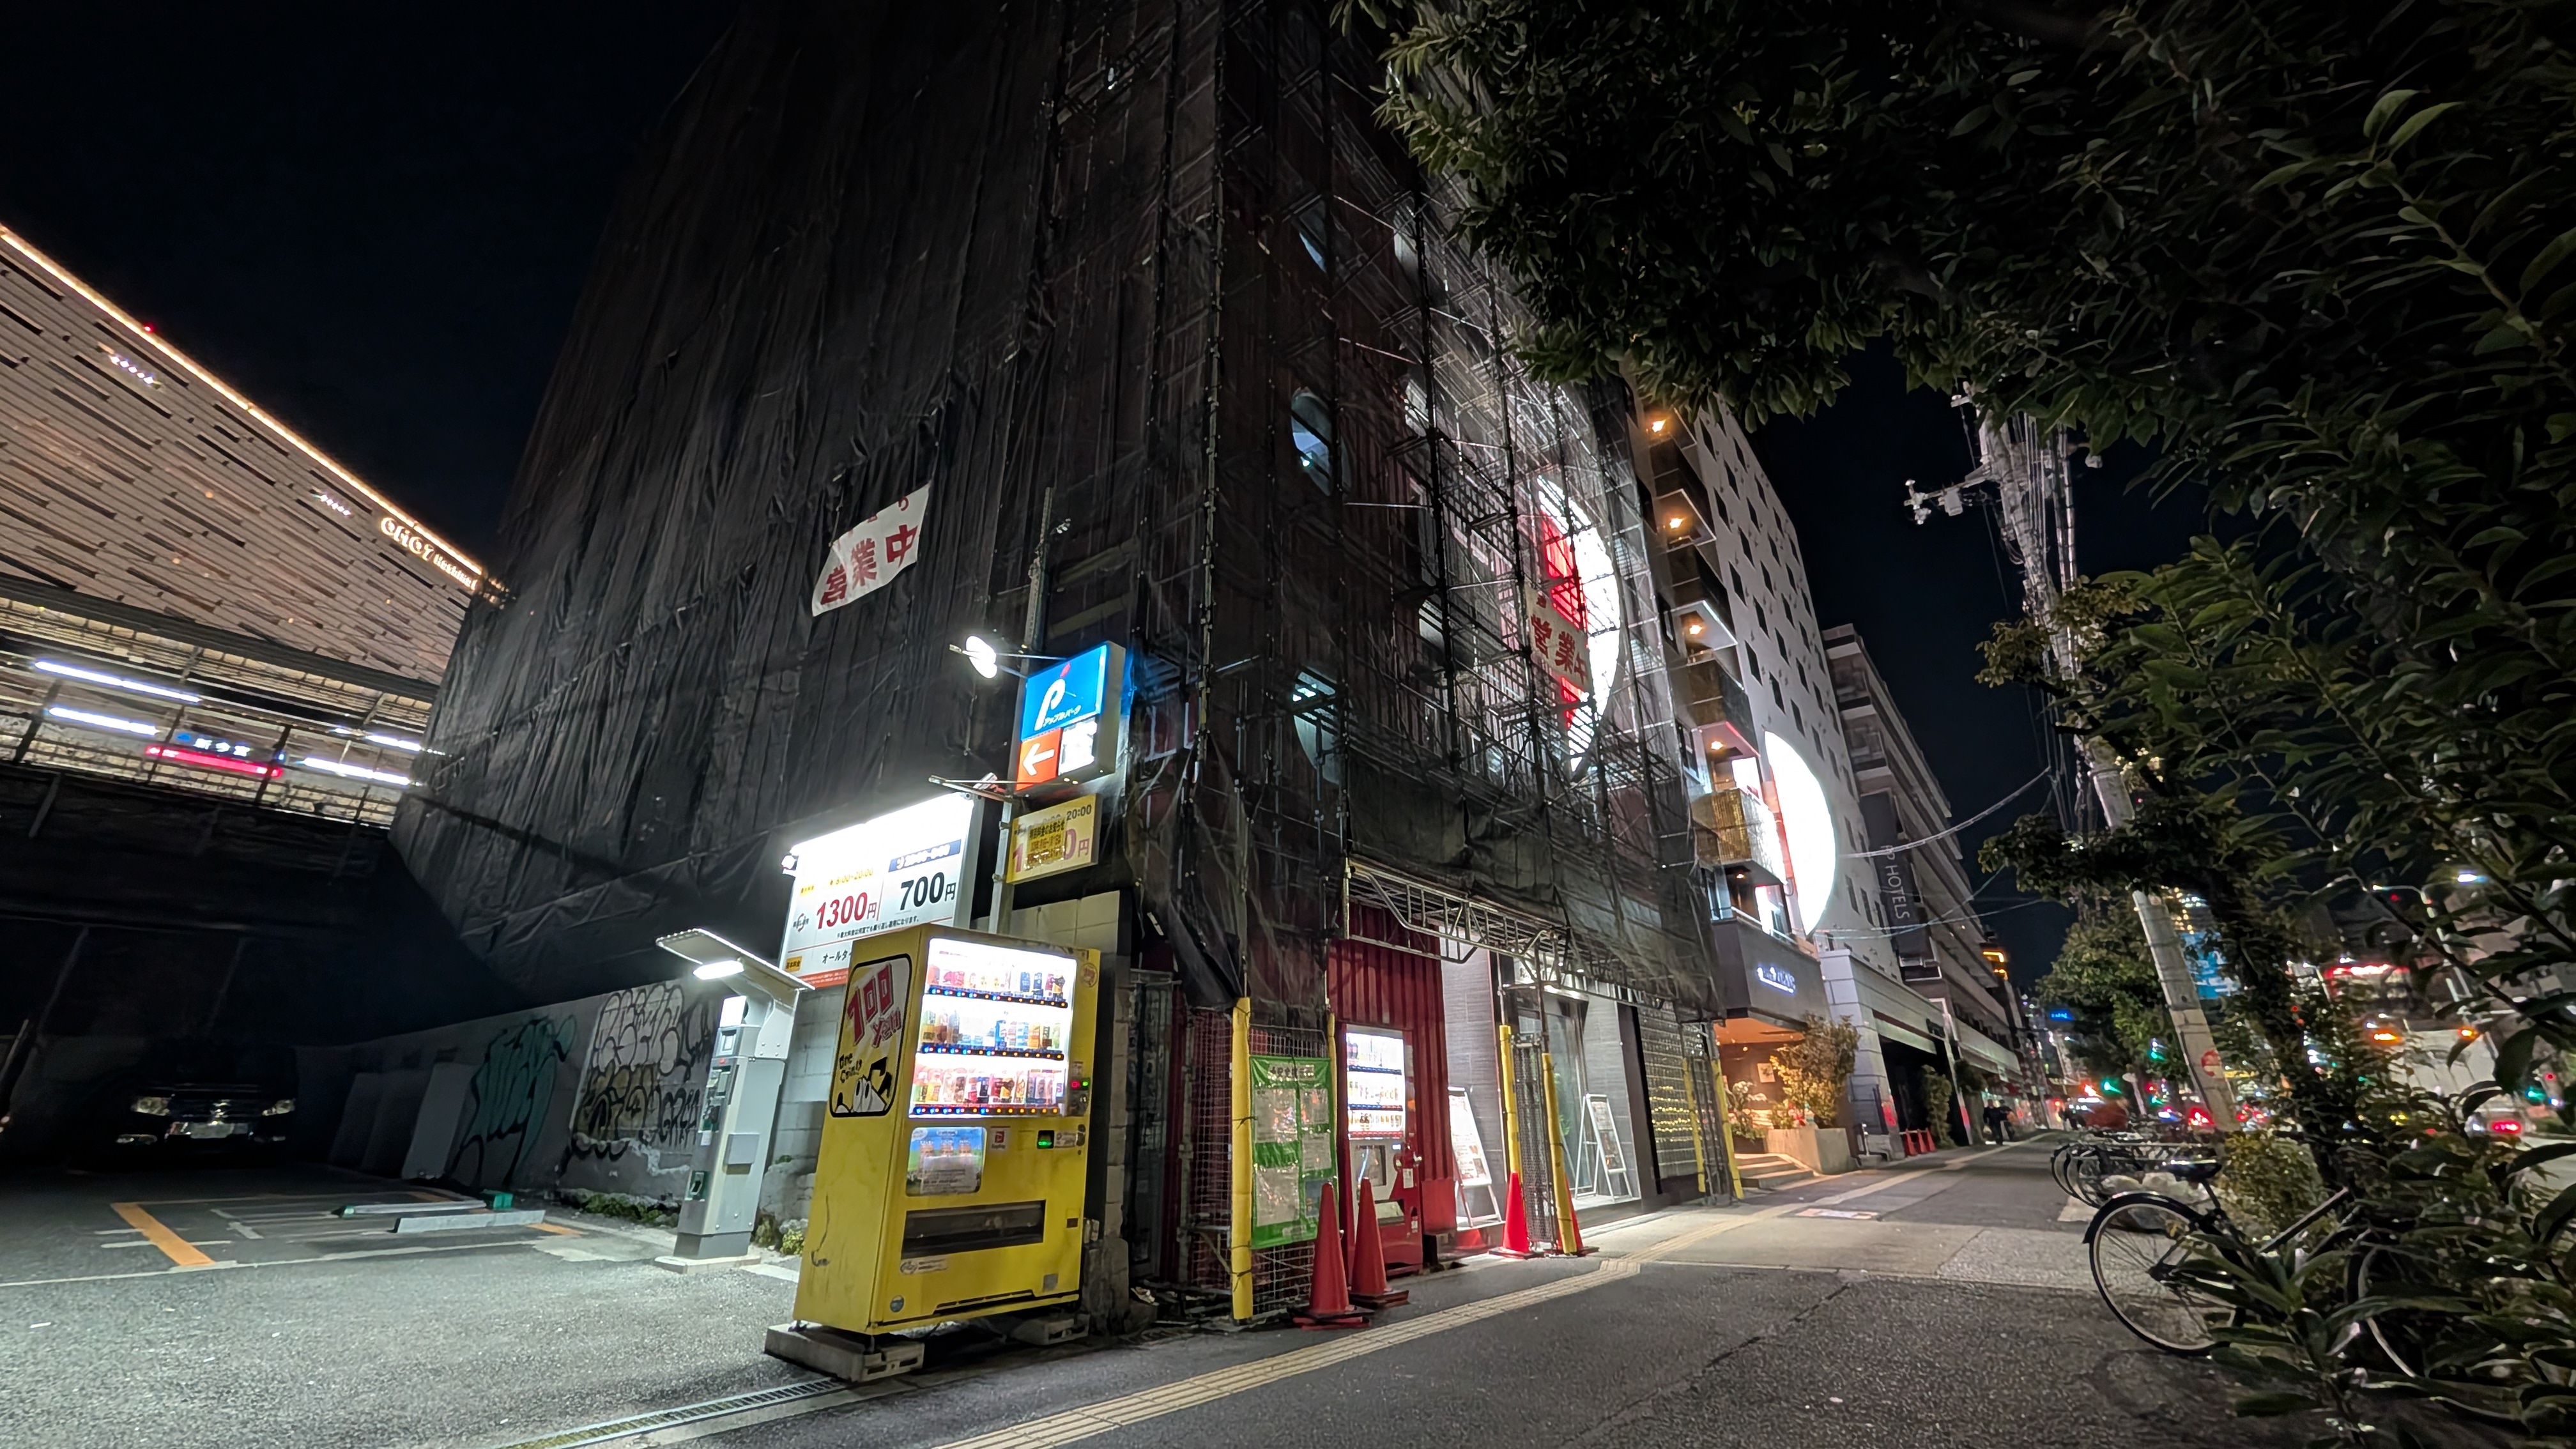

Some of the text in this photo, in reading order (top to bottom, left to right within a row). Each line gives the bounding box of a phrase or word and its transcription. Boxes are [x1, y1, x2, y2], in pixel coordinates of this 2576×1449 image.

[820, 524, 919, 605] 営業中
[1066, 804, 1092, 821] 20:00
[816, 892, 878, 930] 1300円
[900, 871, 956, 911] 700円
[1885, 864, 1910, 919] HOTELS
[822, 950, 852, 964] オールタ
[847, 962, 894, 1046] 100
